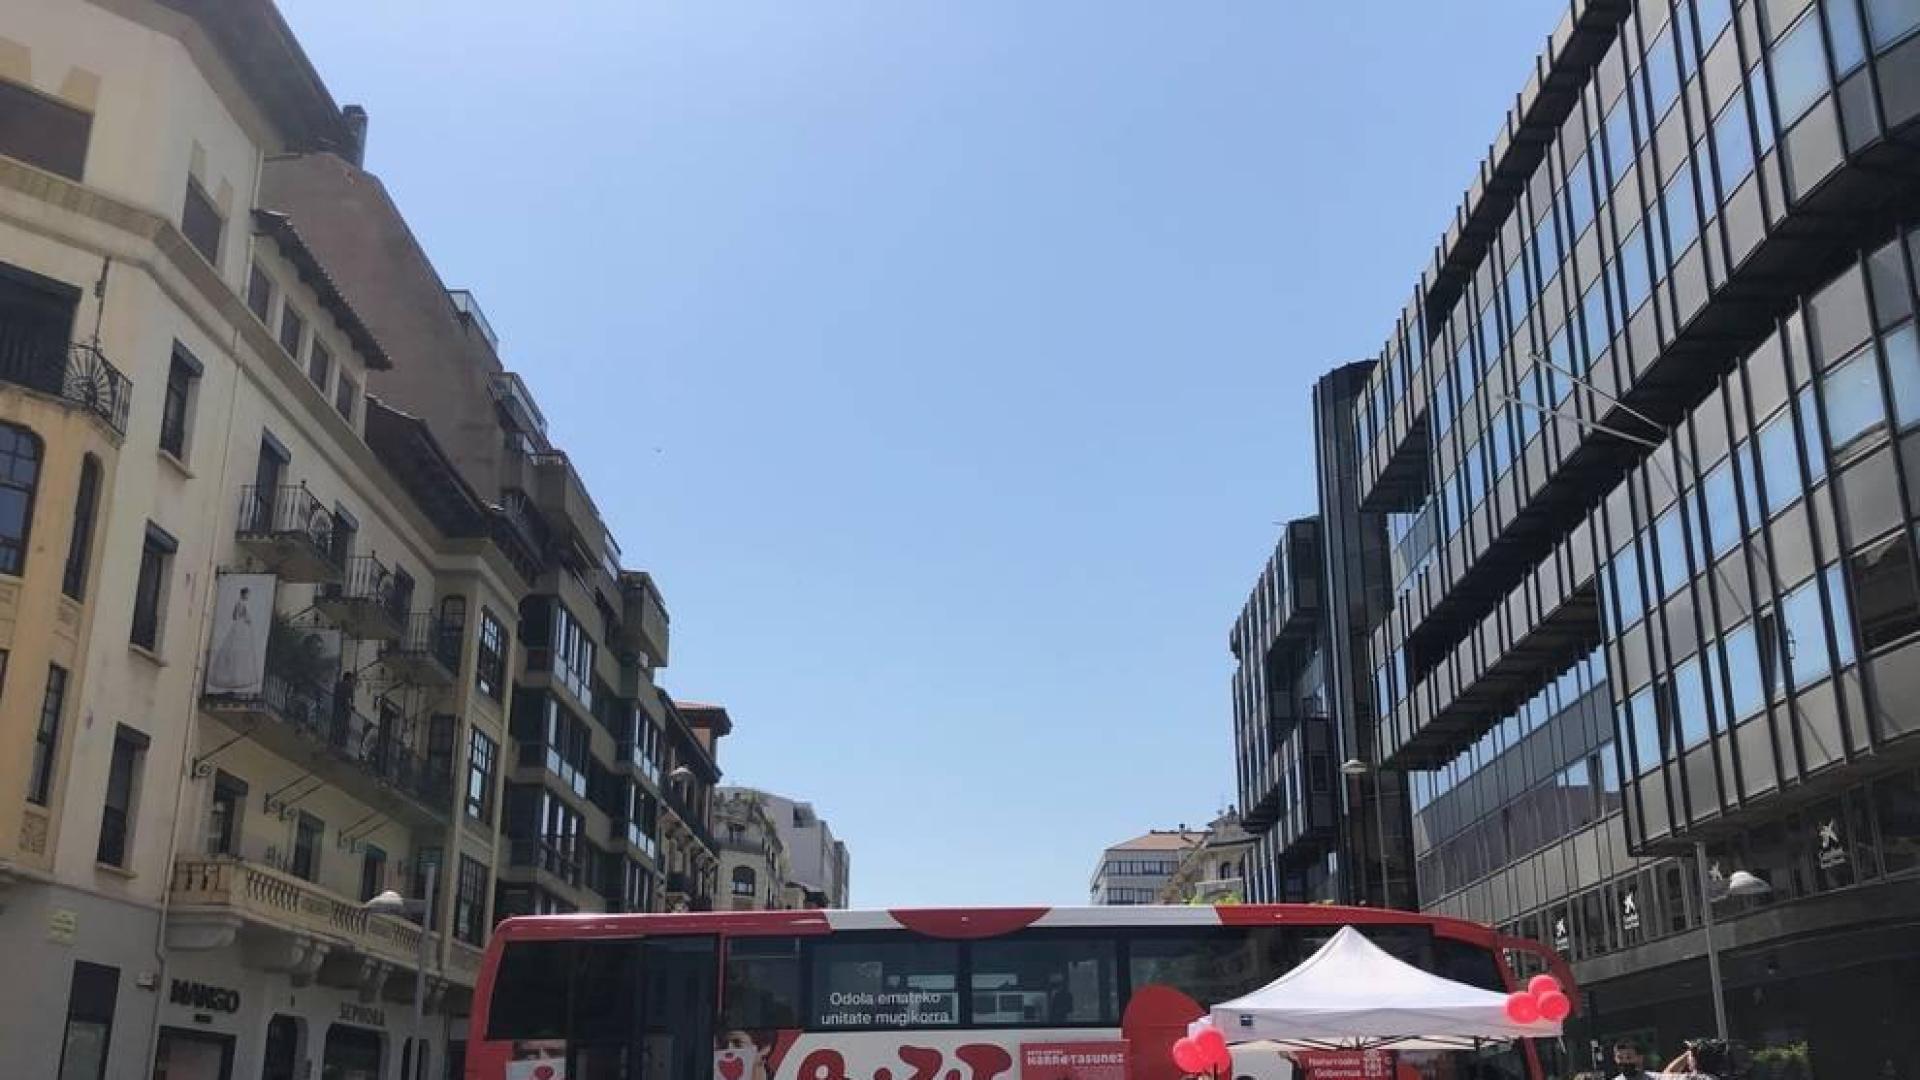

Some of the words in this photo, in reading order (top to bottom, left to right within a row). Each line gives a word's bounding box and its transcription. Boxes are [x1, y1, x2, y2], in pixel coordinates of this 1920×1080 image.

[169, 979, 240, 1014] MANGO
[829, 992, 874, 1005] Odola
[877, 991, 942, 1005] emateko
[821, 1011, 872, 1025] unitate
[875, 1010, 950, 1027] mugikorra
